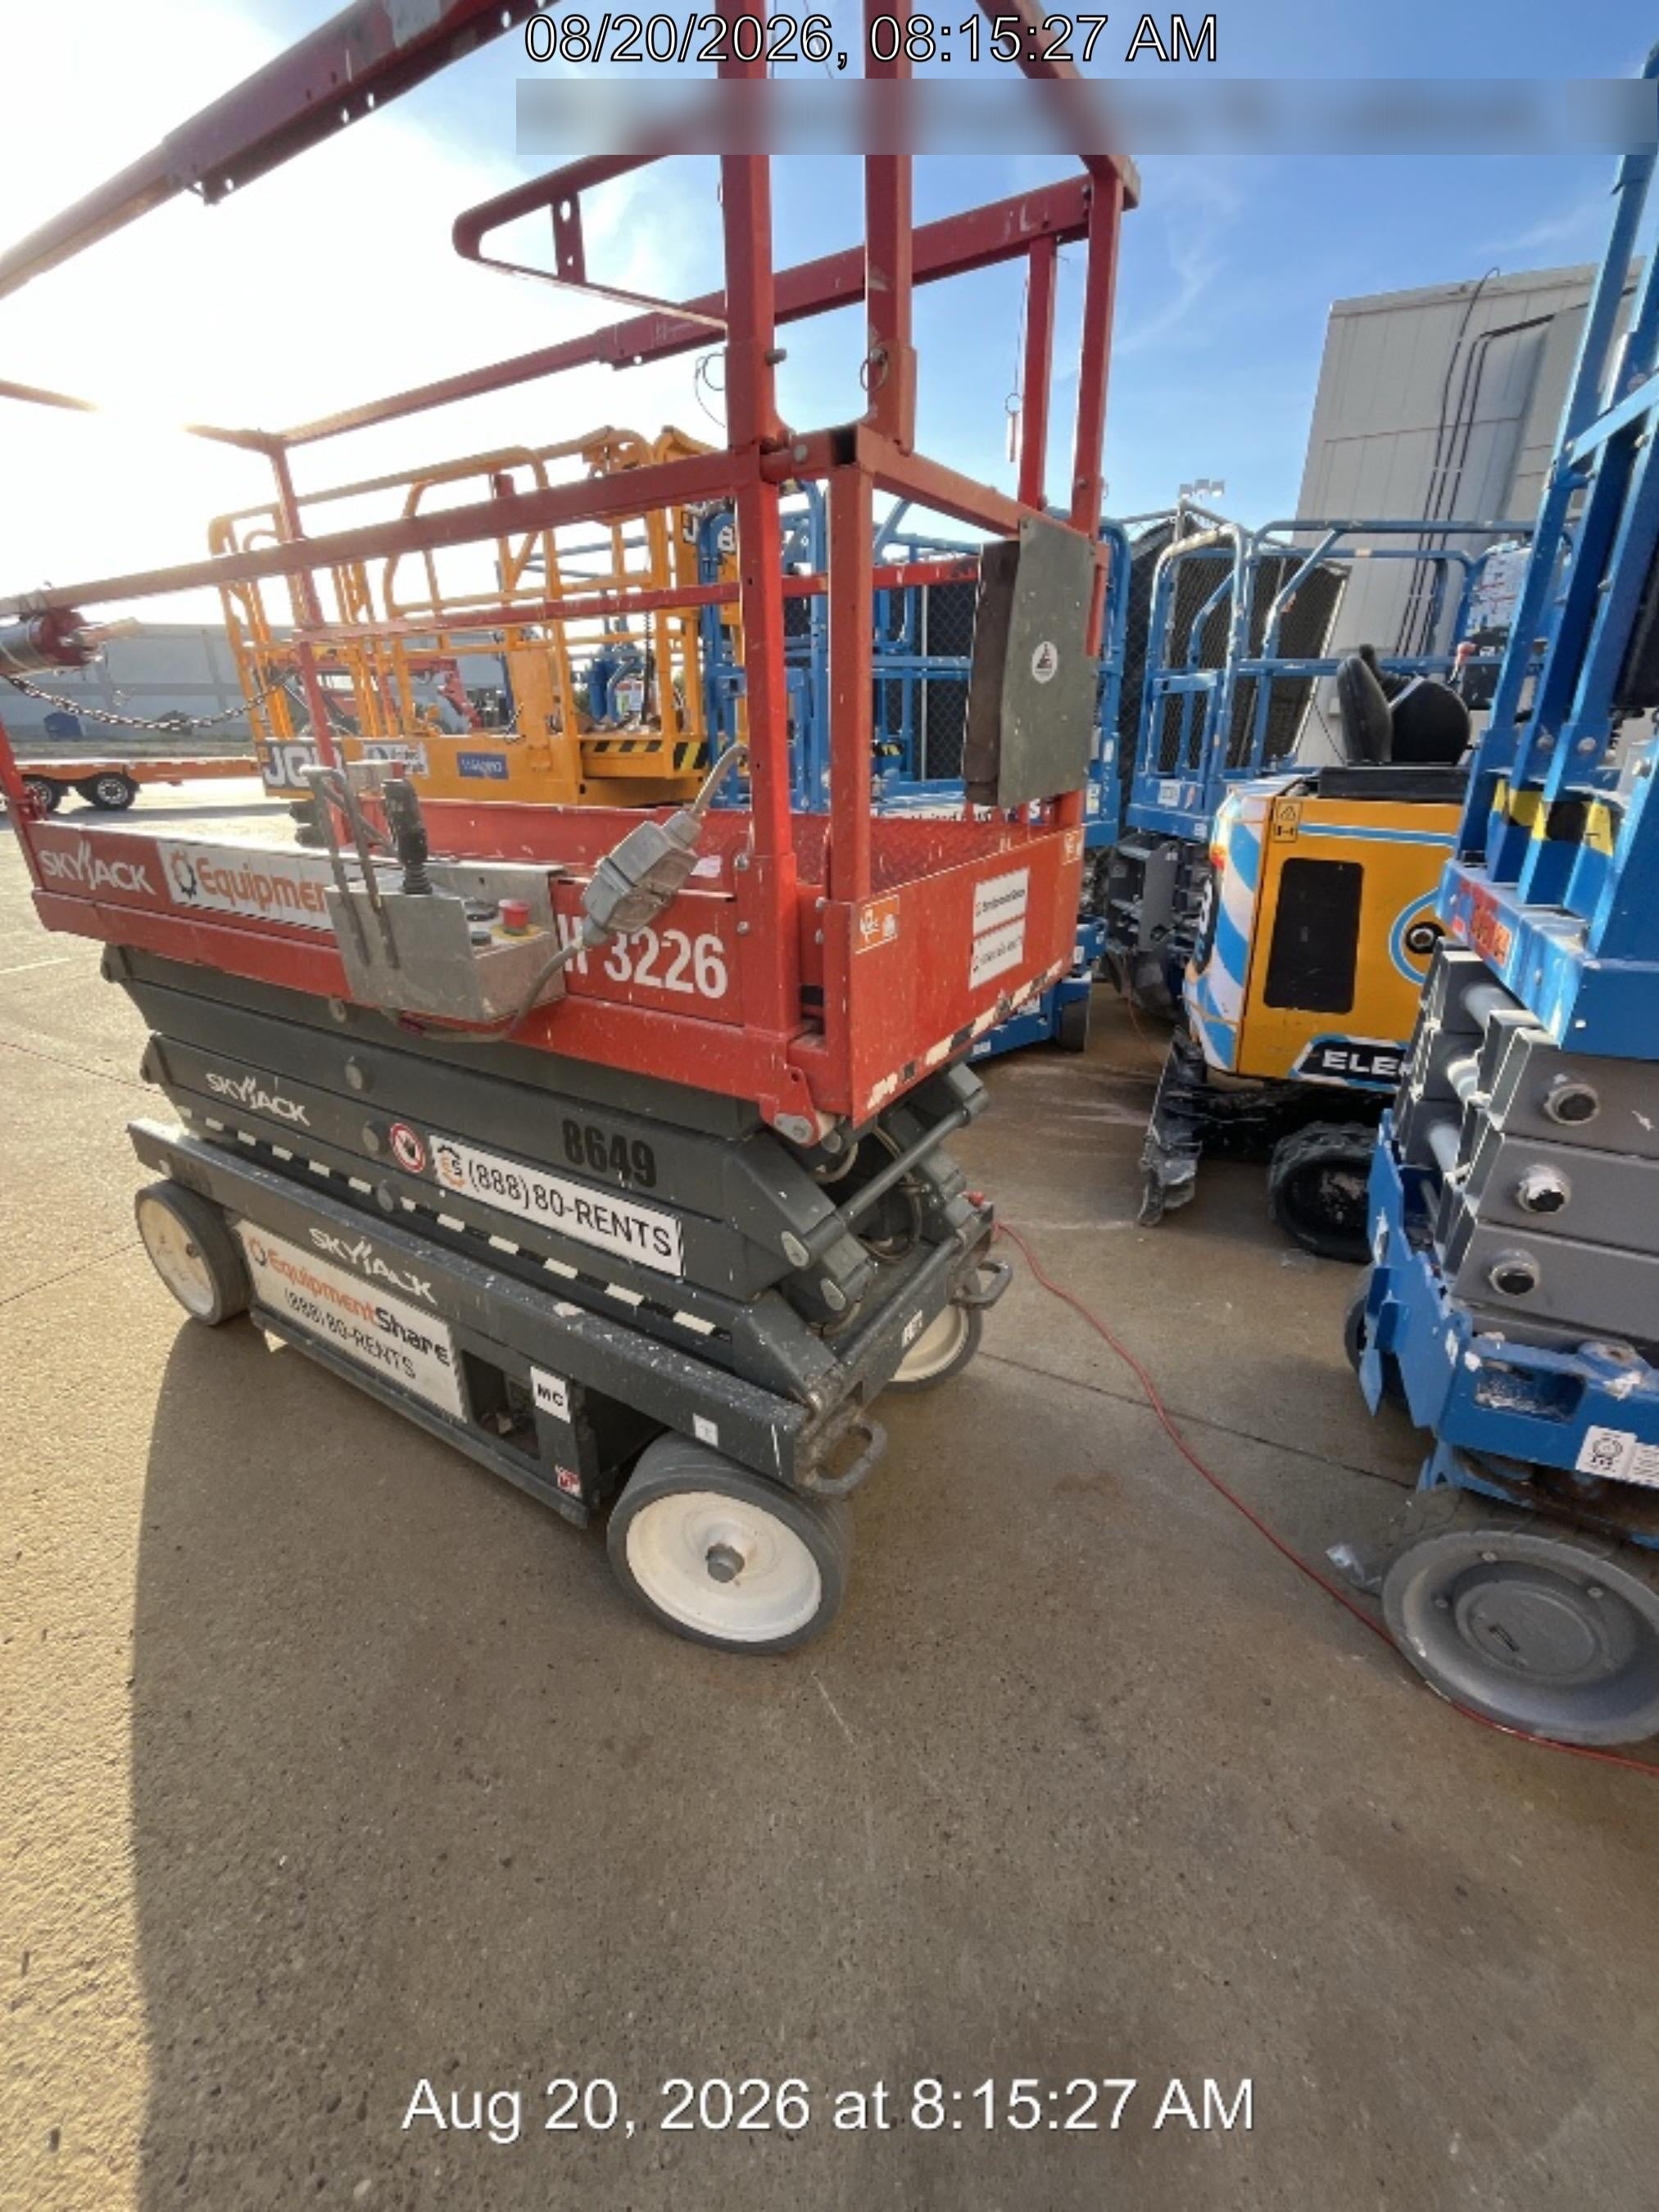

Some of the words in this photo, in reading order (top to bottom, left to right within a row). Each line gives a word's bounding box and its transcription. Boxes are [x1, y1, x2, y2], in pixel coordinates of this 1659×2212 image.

[39, 840, 156, 895] SKYJACK
[604, 926, 728, 999] 3226
[206, 1073, 310, 1126] SKYJACK
[562, 1119, 656, 1188] 8649
[309, 1228, 438, 1306] SKYJACK
[267, 1248, 451, 1367] EquipmentShare
